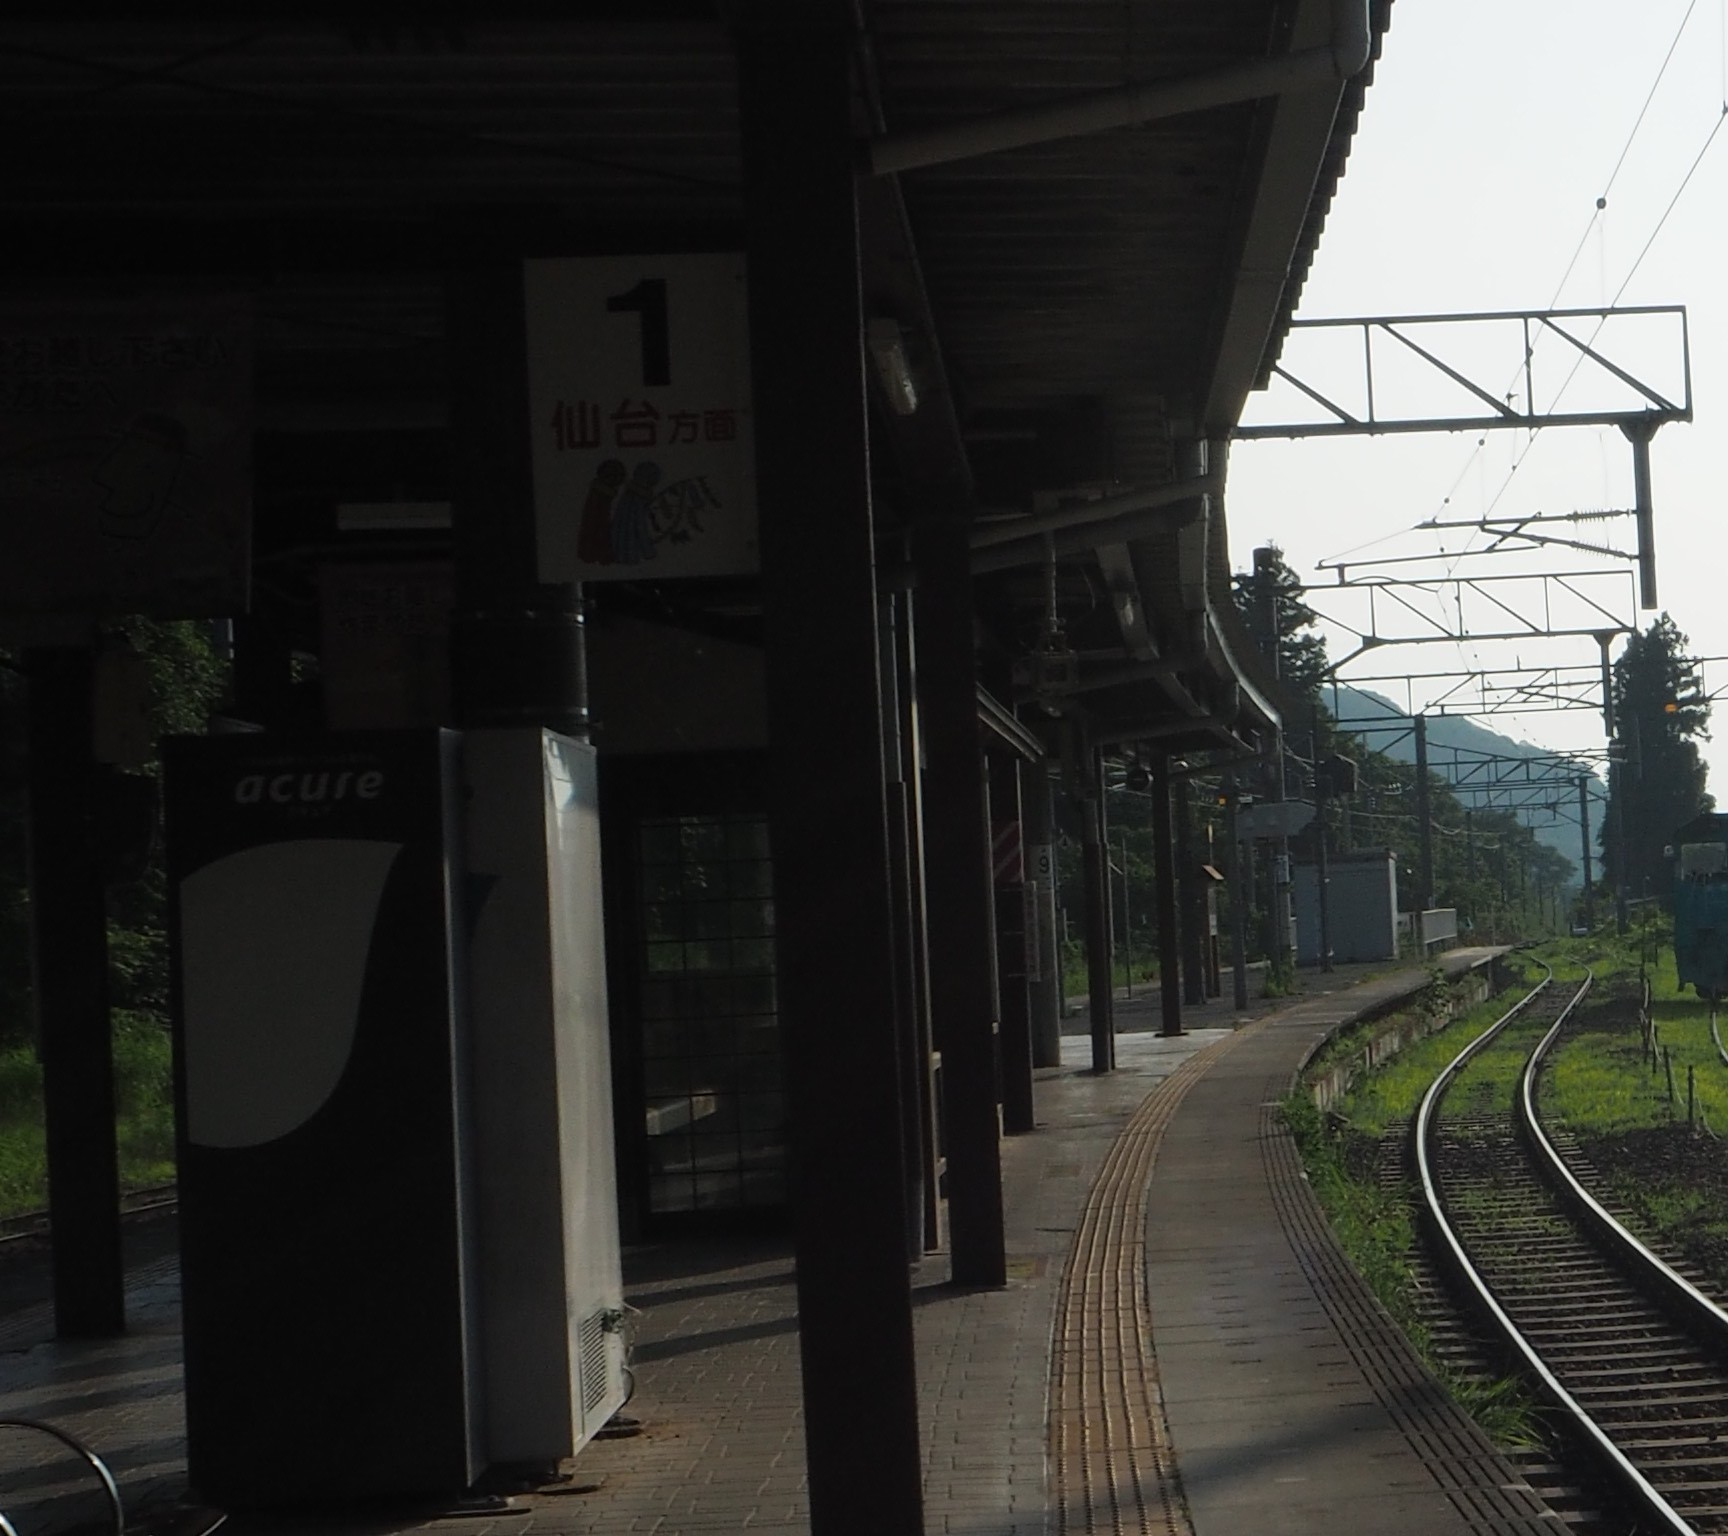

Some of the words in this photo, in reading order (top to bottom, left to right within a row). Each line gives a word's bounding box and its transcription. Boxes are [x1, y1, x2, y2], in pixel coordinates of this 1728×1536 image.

[607, 278, 671, 387] 1
[550, 398, 738, 451] 仙台方面
[235, 770, 384, 804] acure
